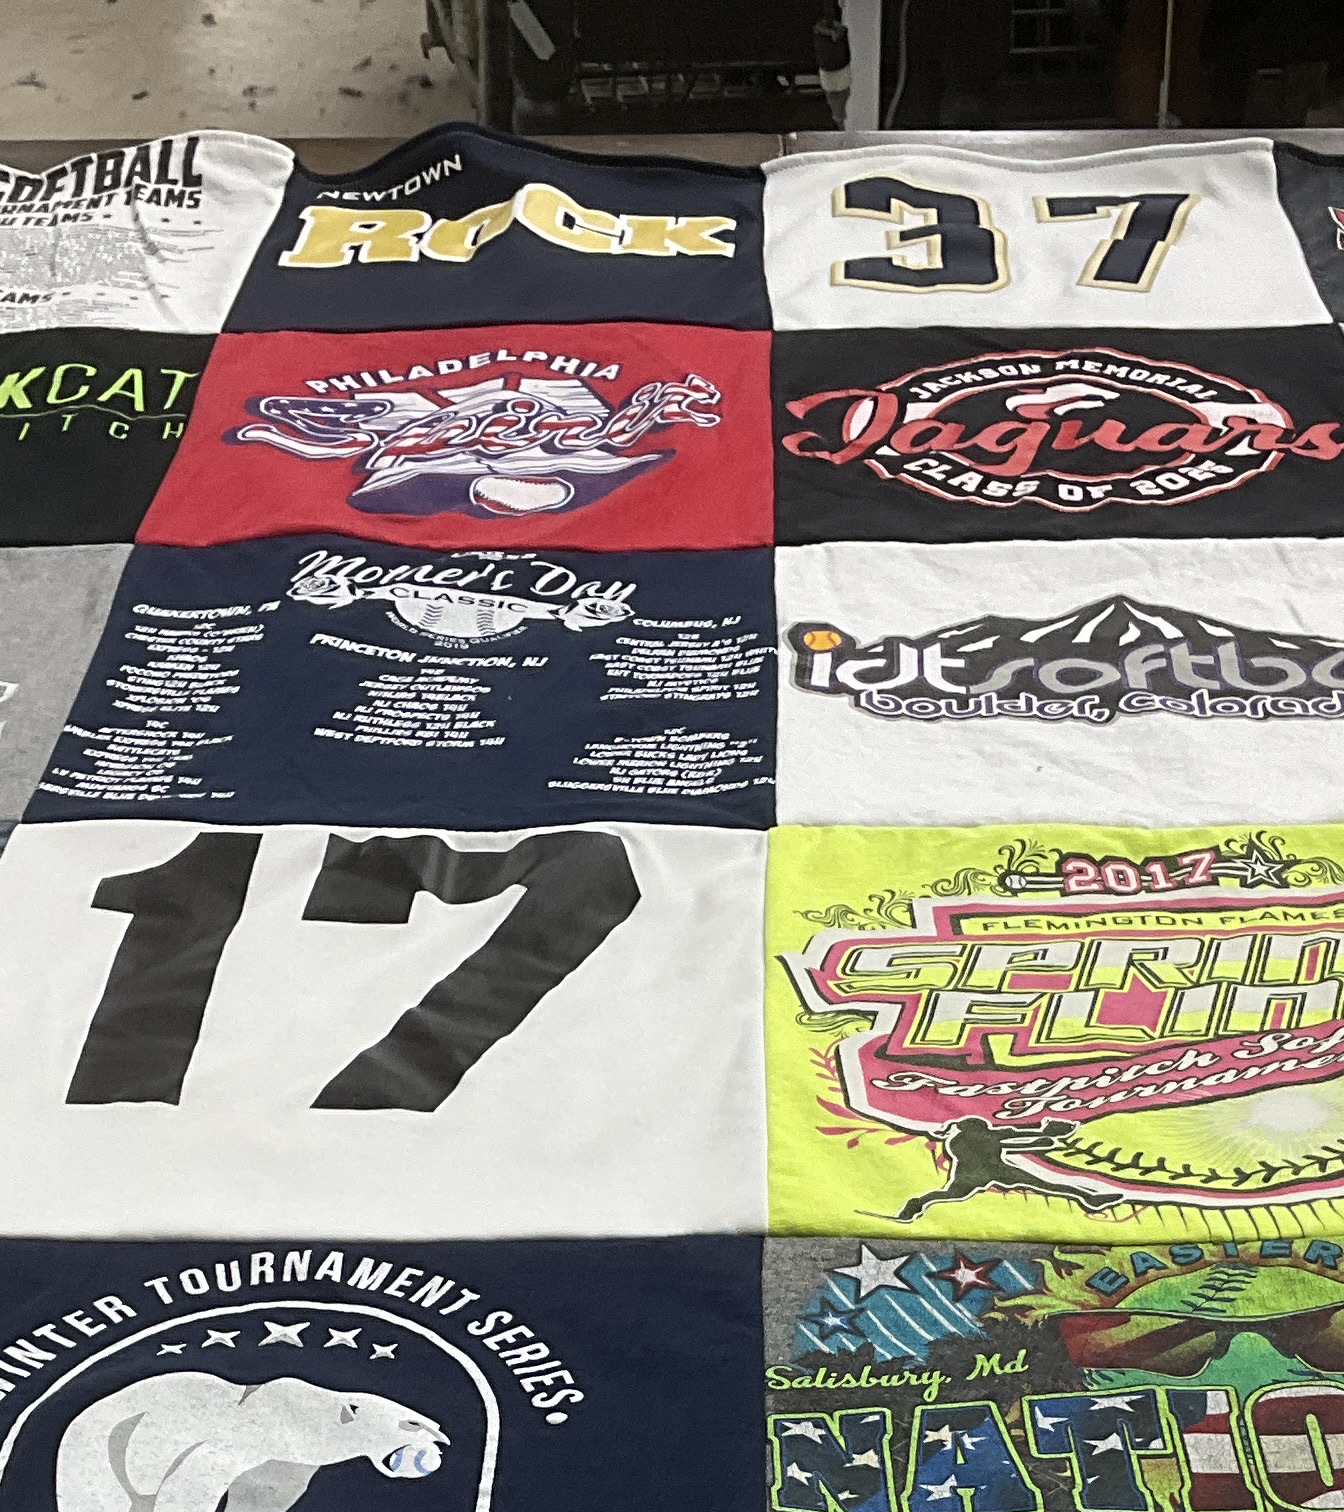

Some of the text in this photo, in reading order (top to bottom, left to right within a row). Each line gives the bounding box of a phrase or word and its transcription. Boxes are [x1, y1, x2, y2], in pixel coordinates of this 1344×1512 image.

[122, 183, 203, 209] TEAMS
[316, 153, 463, 202] NEWTOWN
[277, 182, 737, 268] ROCK
[830, 173, 1202, 295] 37
[304, 348, 625, 395] PHILADELPHIA
[908, 358, 1219, 401] JACKSON MEMORIAL
[902, 457, 1041, 498] CLASS
[389, 587, 530, 614] CLASSIC
[529, 561, 638, 602] Day
[722, 616, 741, 627] NJ
[309, 633, 416, 663] PRINCETON
[522, 656, 548, 667] NJ
[1058, 845, 1219, 895] 2017
[981, 914, 1212, 933] FLEMINGTON
[64, 829, 643, 1114] 17
[870, 1049, 1219, 1099] Fastpitch
[143, 1248, 481, 1318] TOURNAMENT
[464, 1309, 585, 1410] SERIES
[964, 1347, 1031, 1380] Md
